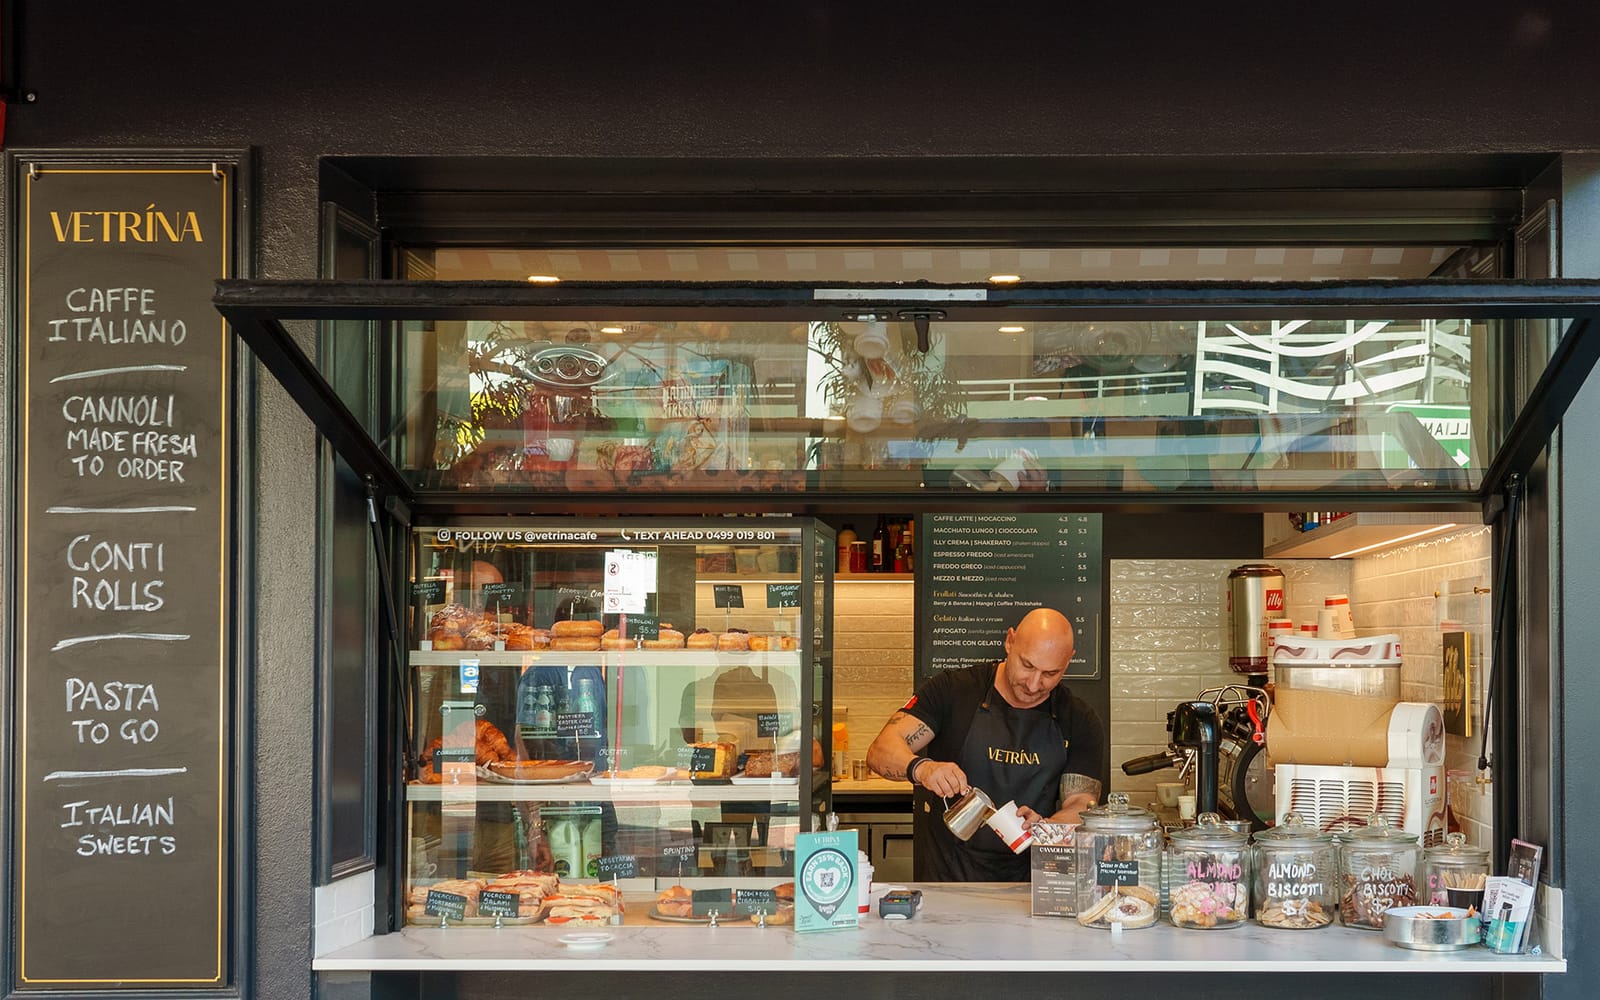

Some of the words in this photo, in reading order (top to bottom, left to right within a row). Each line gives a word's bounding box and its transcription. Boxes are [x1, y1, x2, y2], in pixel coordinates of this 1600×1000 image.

[50, 204, 203, 242] VETRÍNA
[66, 287, 156, 315] CAFFE
[49, 318, 187, 345] ITALIANO
[62, 395, 174, 427] CANNOLI
[67, 428, 129, 453] MADE
[131, 431, 197, 457] FRESH
[72, 455, 103, 477] TO
[118, 459, 185, 483] ORDER
[455, 531, 504, 540] FOLLOW
[506, 531, 522, 540] US
[524, 530, 598, 542] @vetrinacafe
[633, 531, 662, 540] TEXT
[663, 531, 703, 540] AHEAD
[706, 531, 734, 540] 0499
[736, 531, 754, 540] 019
[756, 531, 775, 540] 801
[67, 534, 164, 573] CONTI
[72, 577, 165, 611] ROLLS
[1268, 592, 1283, 608] illy
[65, 678, 159, 712] PASTA
[72, 720, 109, 744] TO
[120, 719, 159, 744] GO
[988, 746, 1040, 765] VETRÍNA
[60, 797, 174, 829] ITALIAN
[76, 835, 176, 857] SWEETS
[1187, 861, 1242, 880] ALMOND
[1268, 863, 1316, 880] ALMOND
[1268, 882, 1324, 898] BISCOTTI
[1363, 880, 1410, 897] BISCOTTI
